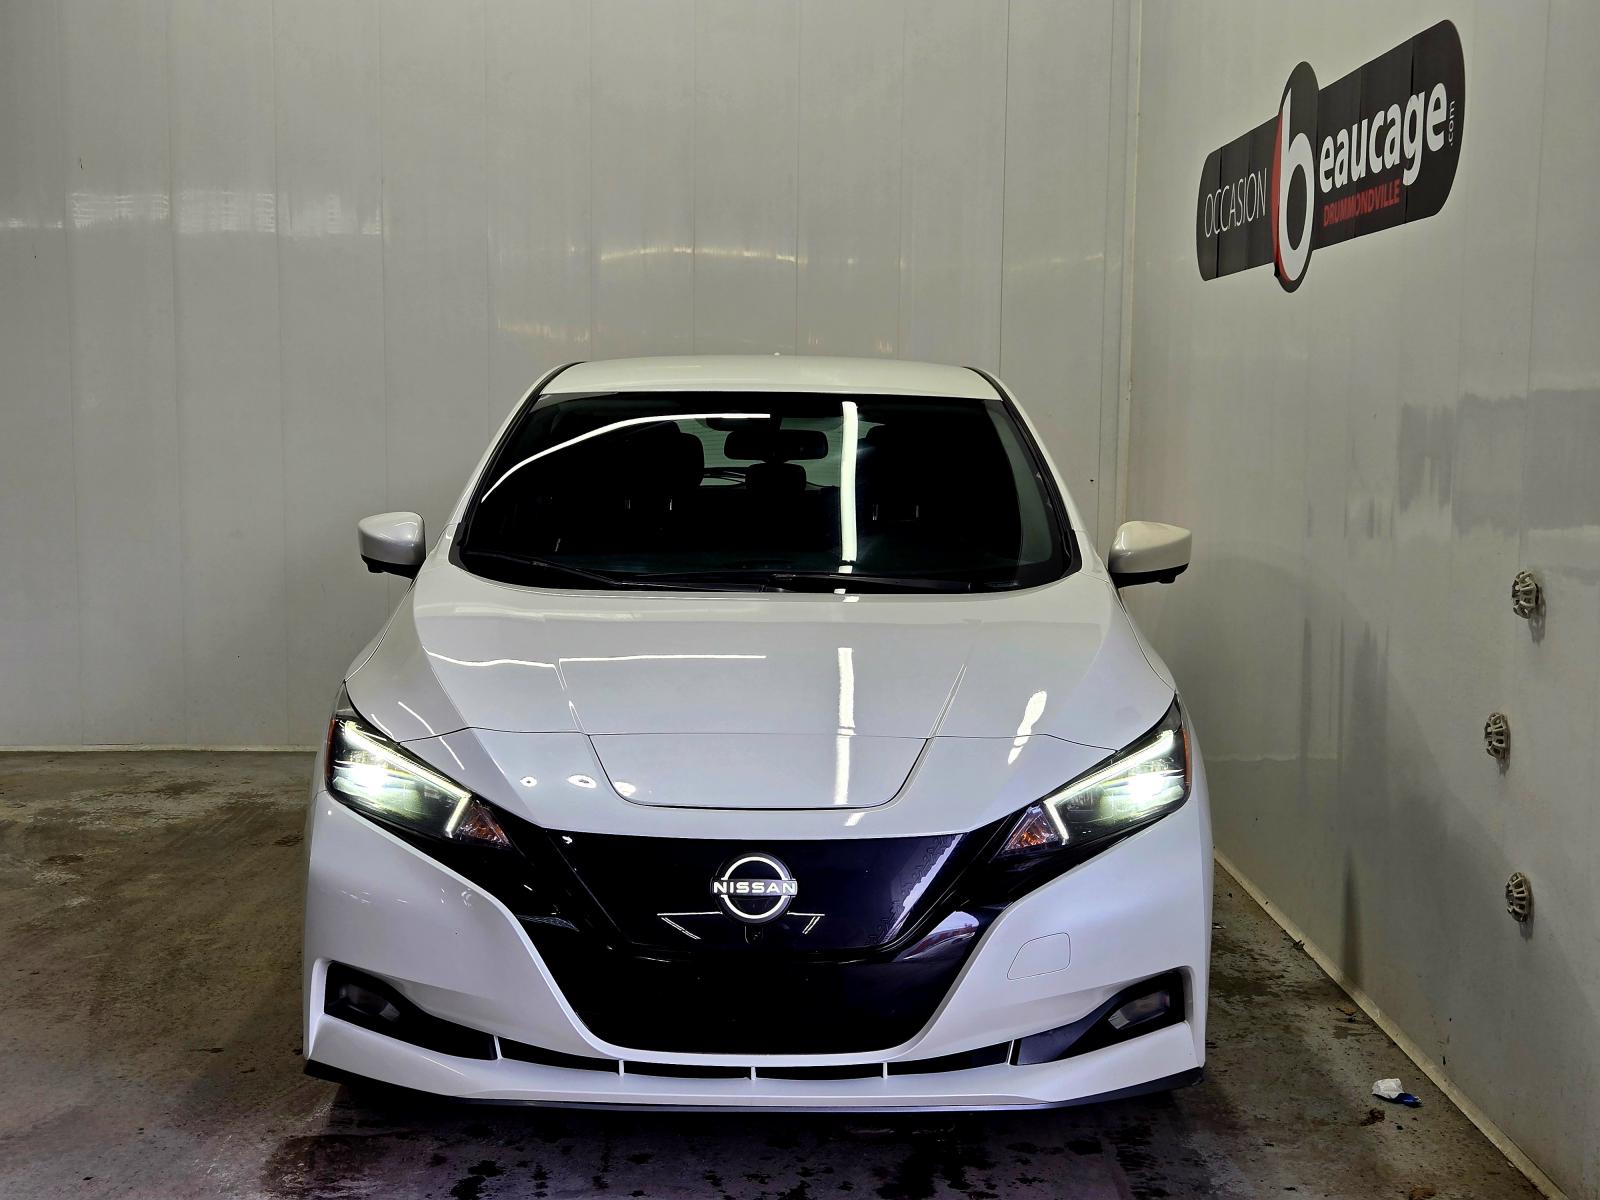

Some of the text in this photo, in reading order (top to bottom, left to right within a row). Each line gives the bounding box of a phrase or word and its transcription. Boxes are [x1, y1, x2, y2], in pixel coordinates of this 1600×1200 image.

[1204, 167, 1267, 238] OCCASION
[1278, 82, 1447, 281] beaucage
[1323, 178, 1401, 227] DRUMMONDVILLE
[713, 881, 796, 894] NISSAN
